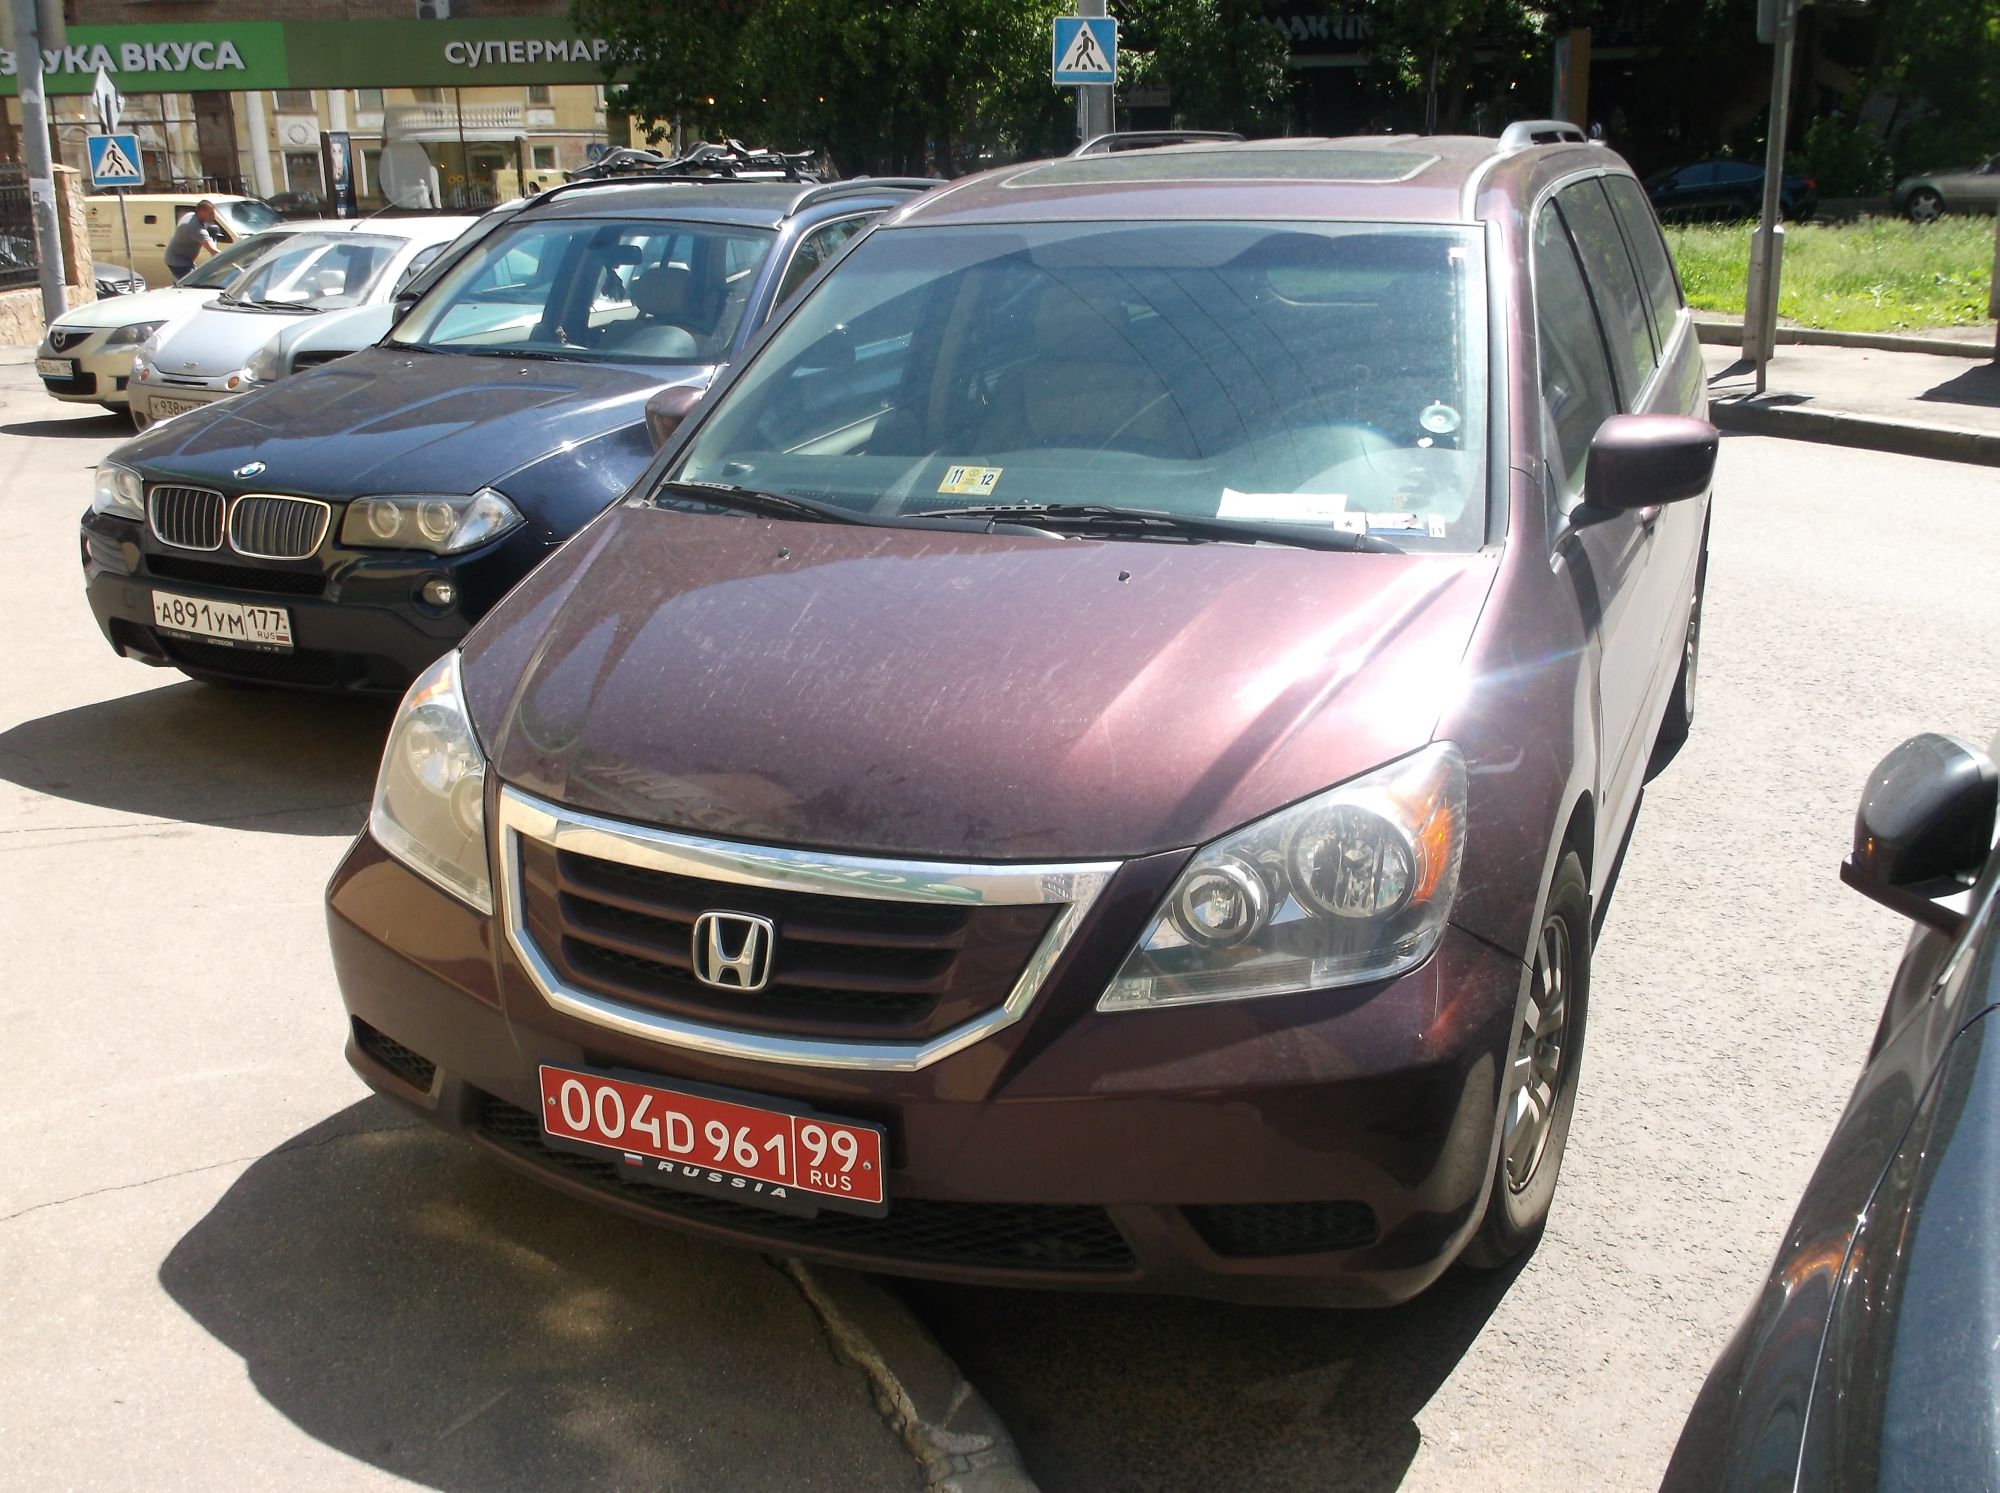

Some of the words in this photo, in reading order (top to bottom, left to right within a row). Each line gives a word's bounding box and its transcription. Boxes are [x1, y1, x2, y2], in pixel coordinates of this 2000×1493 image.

[0, 43, 118, 75] ЗУКА
[120, 40, 246, 72] ВКУСА
[444, 38, 667, 68] СУПЕРМАР
[951, 469, 965, 484] 11
[981, 473, 995, 486] 12
[162, 599, 245, 635] А891УМ
[247, 609, 281, 631] 177
[257, 630, 276, 640] RUS
[800, 1124, 859, 1173] 99
[657, 1160, 787, 1199] RUSSIA
[810, 1169, 852, 1192] RUS
